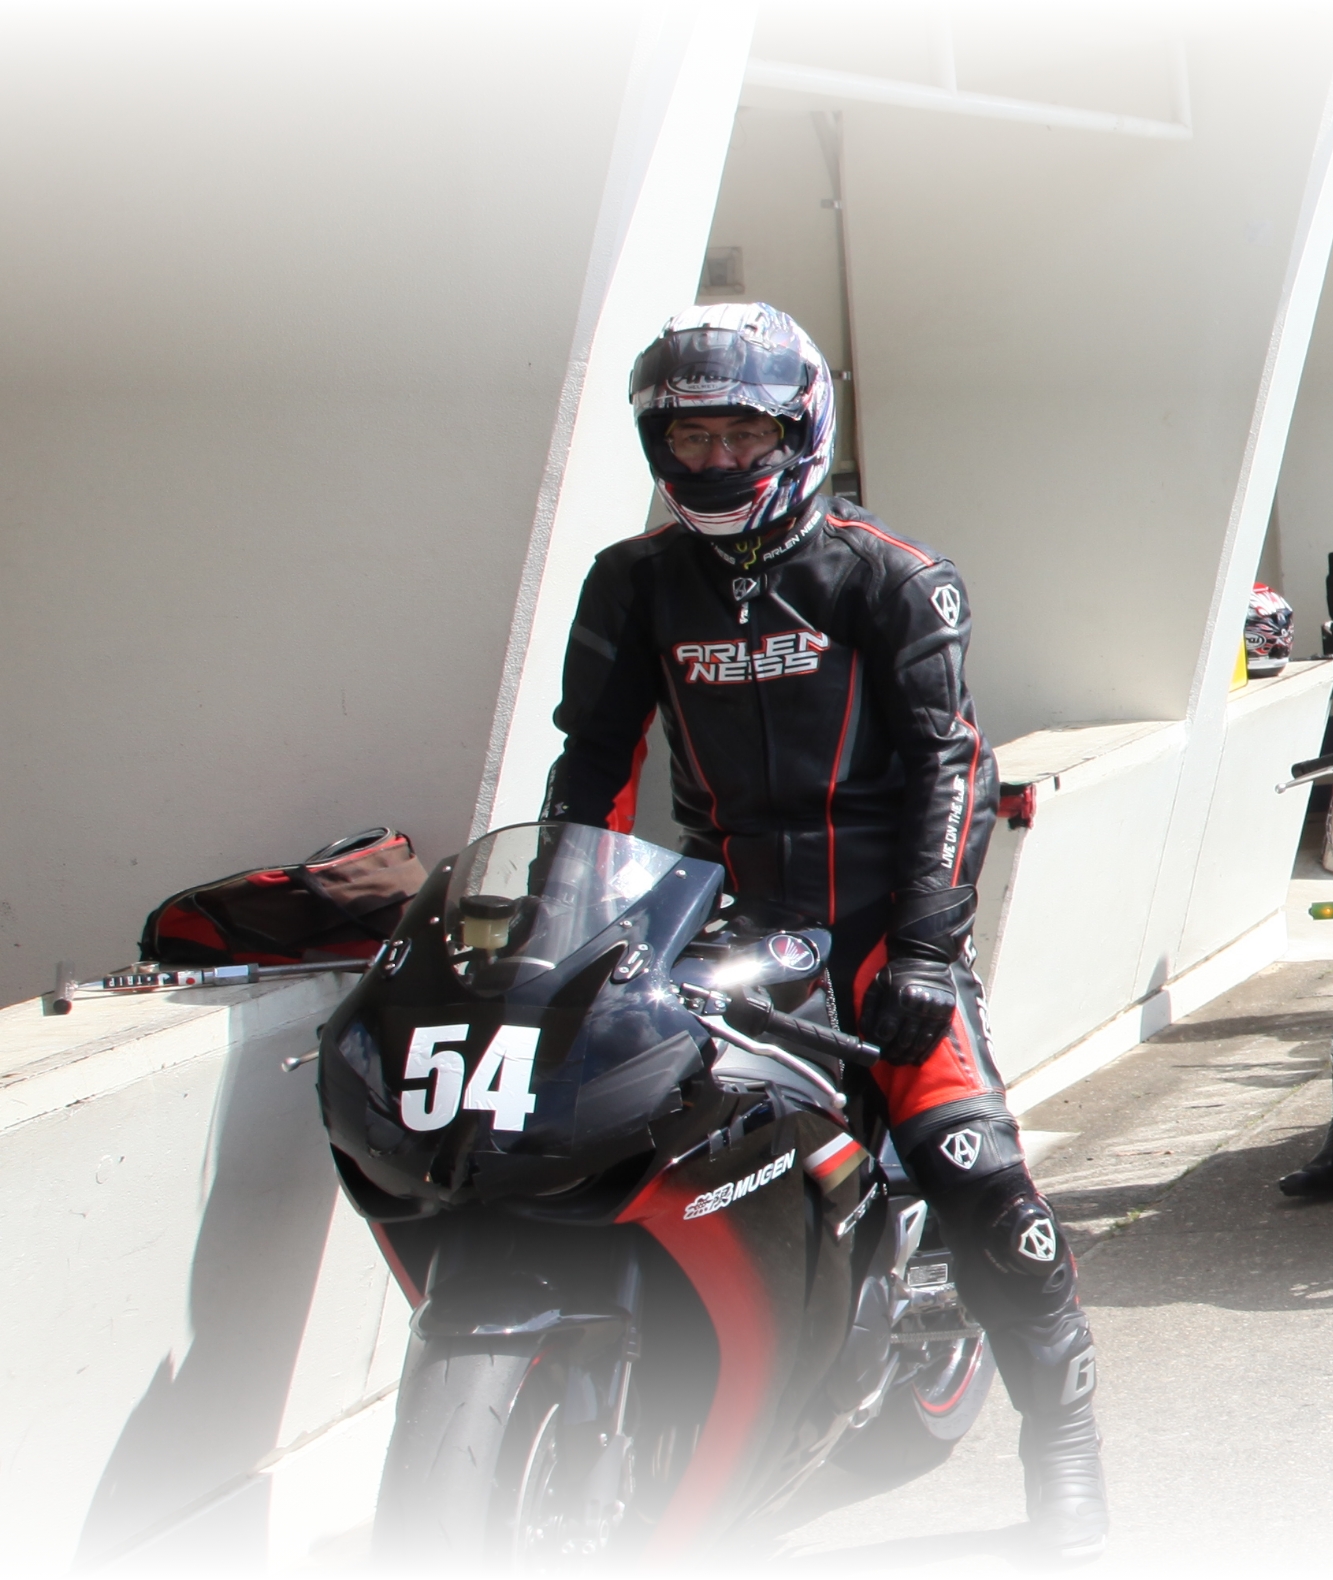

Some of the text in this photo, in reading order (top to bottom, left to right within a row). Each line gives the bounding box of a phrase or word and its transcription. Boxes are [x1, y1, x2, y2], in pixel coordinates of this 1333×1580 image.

[762, 534, 801, 562] ARLEN
[675, 631, 830, 664] ARLEN
[688, 651, 822, 683] NESS
[400, 1022, 541, 1132] 54
[733, 1148, 797, 1200] MUGEN
